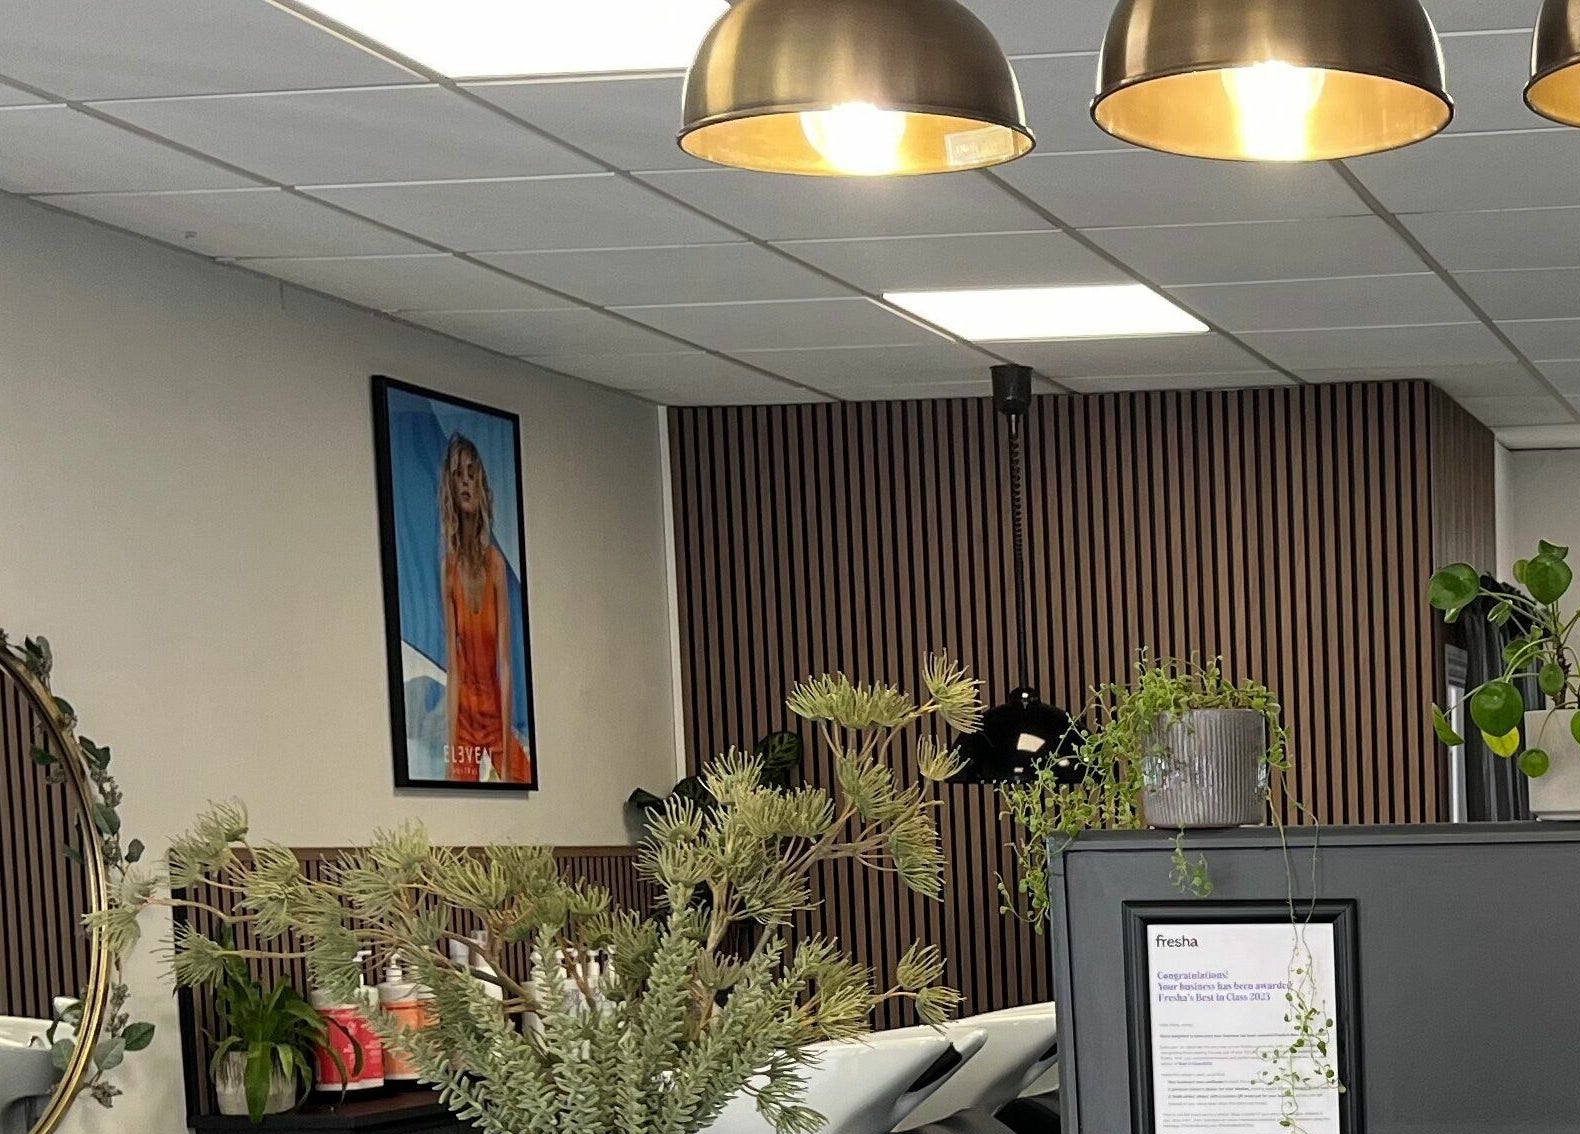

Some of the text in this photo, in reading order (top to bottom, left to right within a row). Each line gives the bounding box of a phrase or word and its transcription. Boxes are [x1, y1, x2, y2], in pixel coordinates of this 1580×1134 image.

[1156, 934, 1198, 948] fresha
[1158, 982, 1178, 990] Your
[1180, 982, 1215, 990] business
[1217, 981, 1232, 990] has
[1226, 992, 1248, 1001] Class
